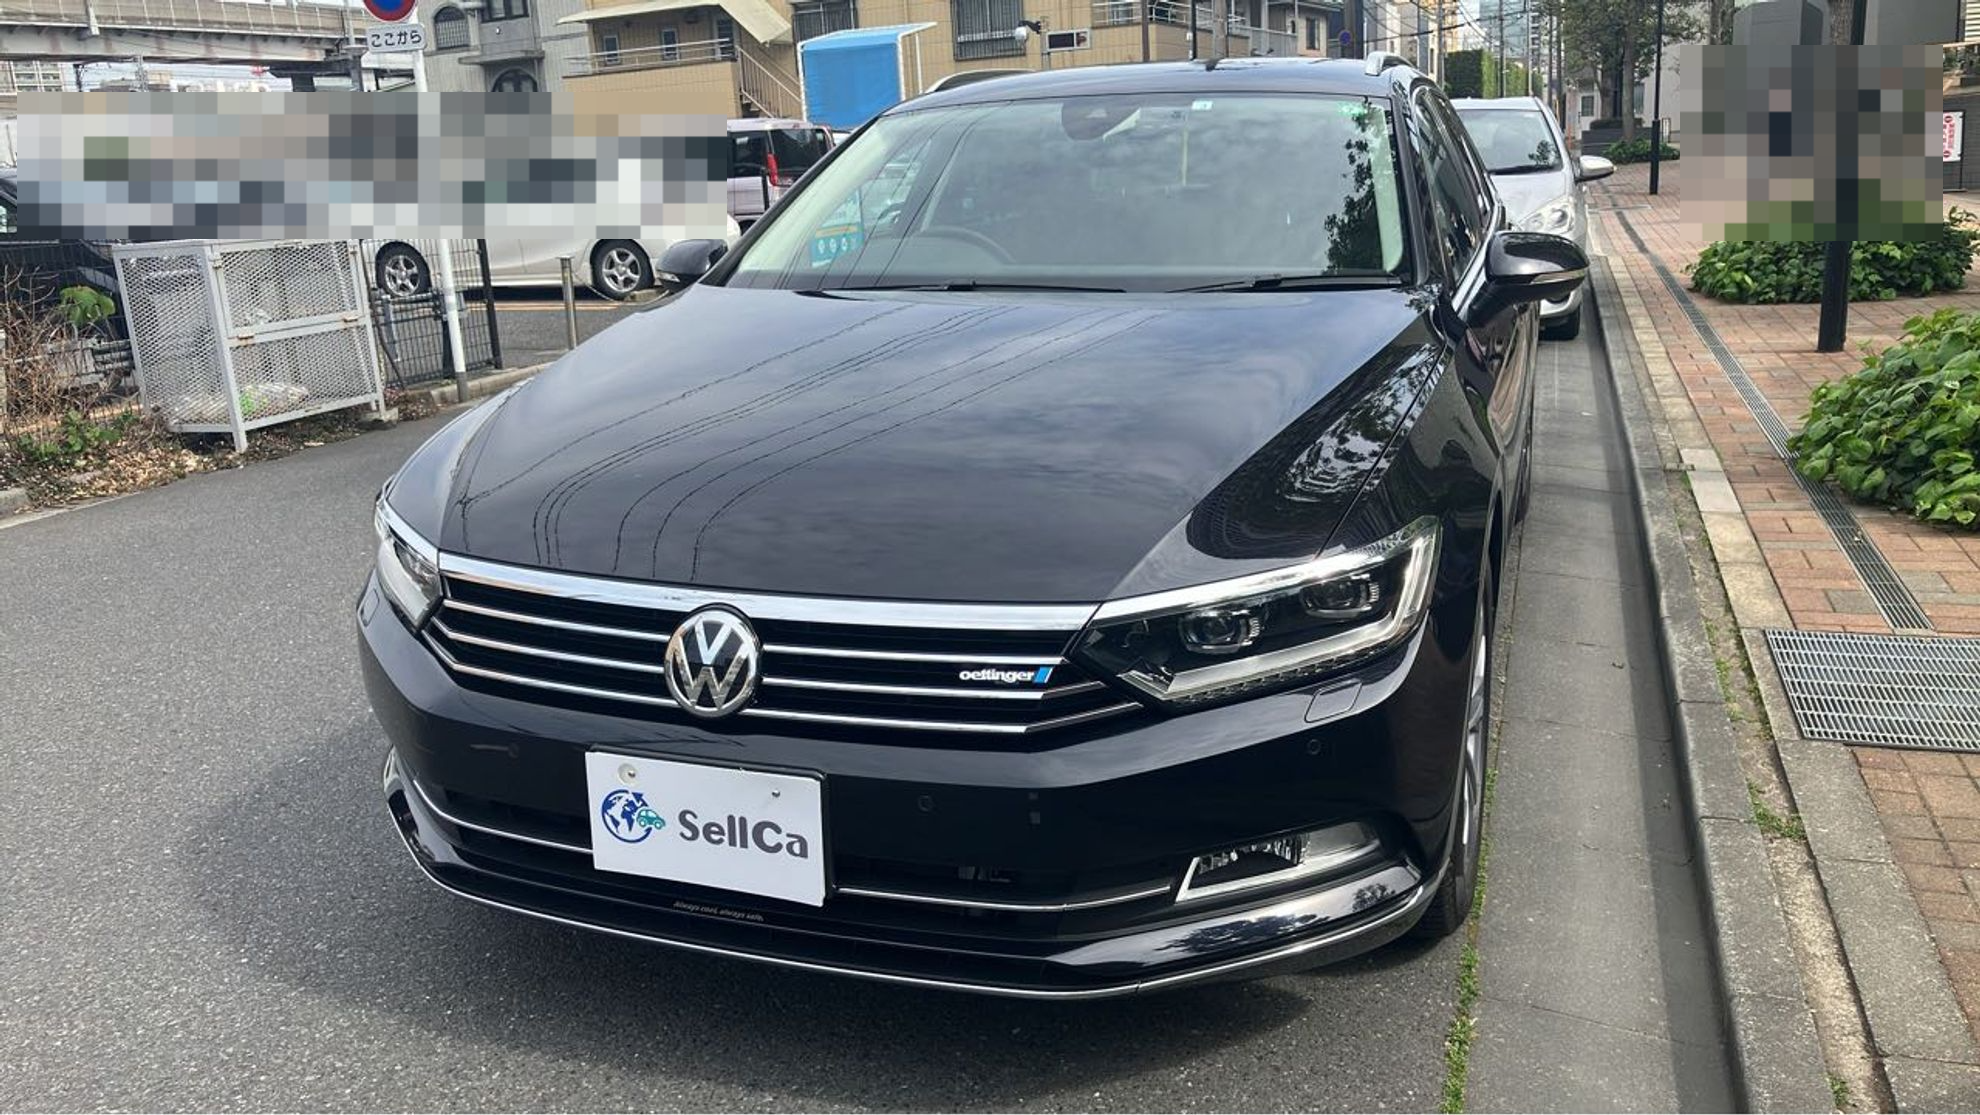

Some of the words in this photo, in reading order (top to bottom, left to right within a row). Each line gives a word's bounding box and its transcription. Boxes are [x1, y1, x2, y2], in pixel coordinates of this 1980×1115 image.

[371, 30, 422, 47] ここから
[666, 609, 755, 716] VW
[959, 668, 1035, 683] oettinger
[678, 809, 808, 859] SellCa
